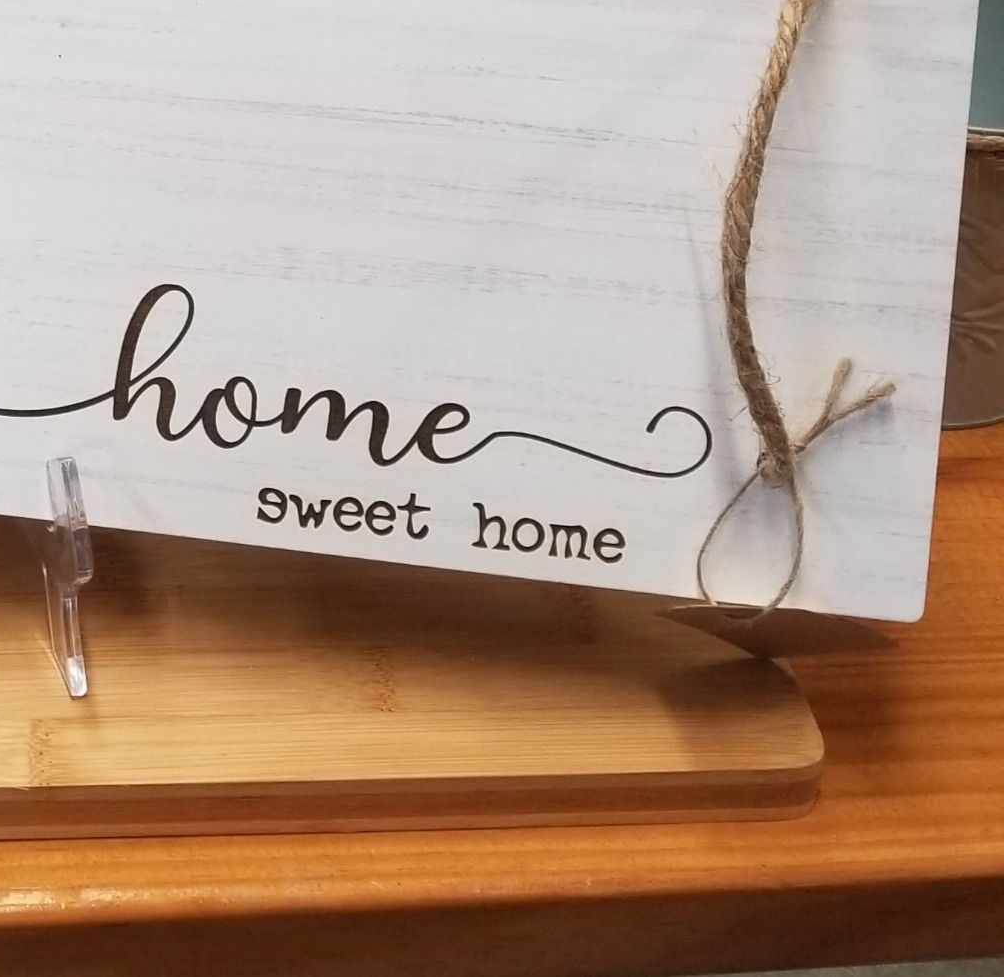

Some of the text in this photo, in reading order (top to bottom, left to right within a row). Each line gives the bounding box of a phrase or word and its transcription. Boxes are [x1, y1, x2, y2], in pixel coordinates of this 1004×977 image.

[108, 284, 712, 477] home
[256, 486, 627, 565] sweet home
